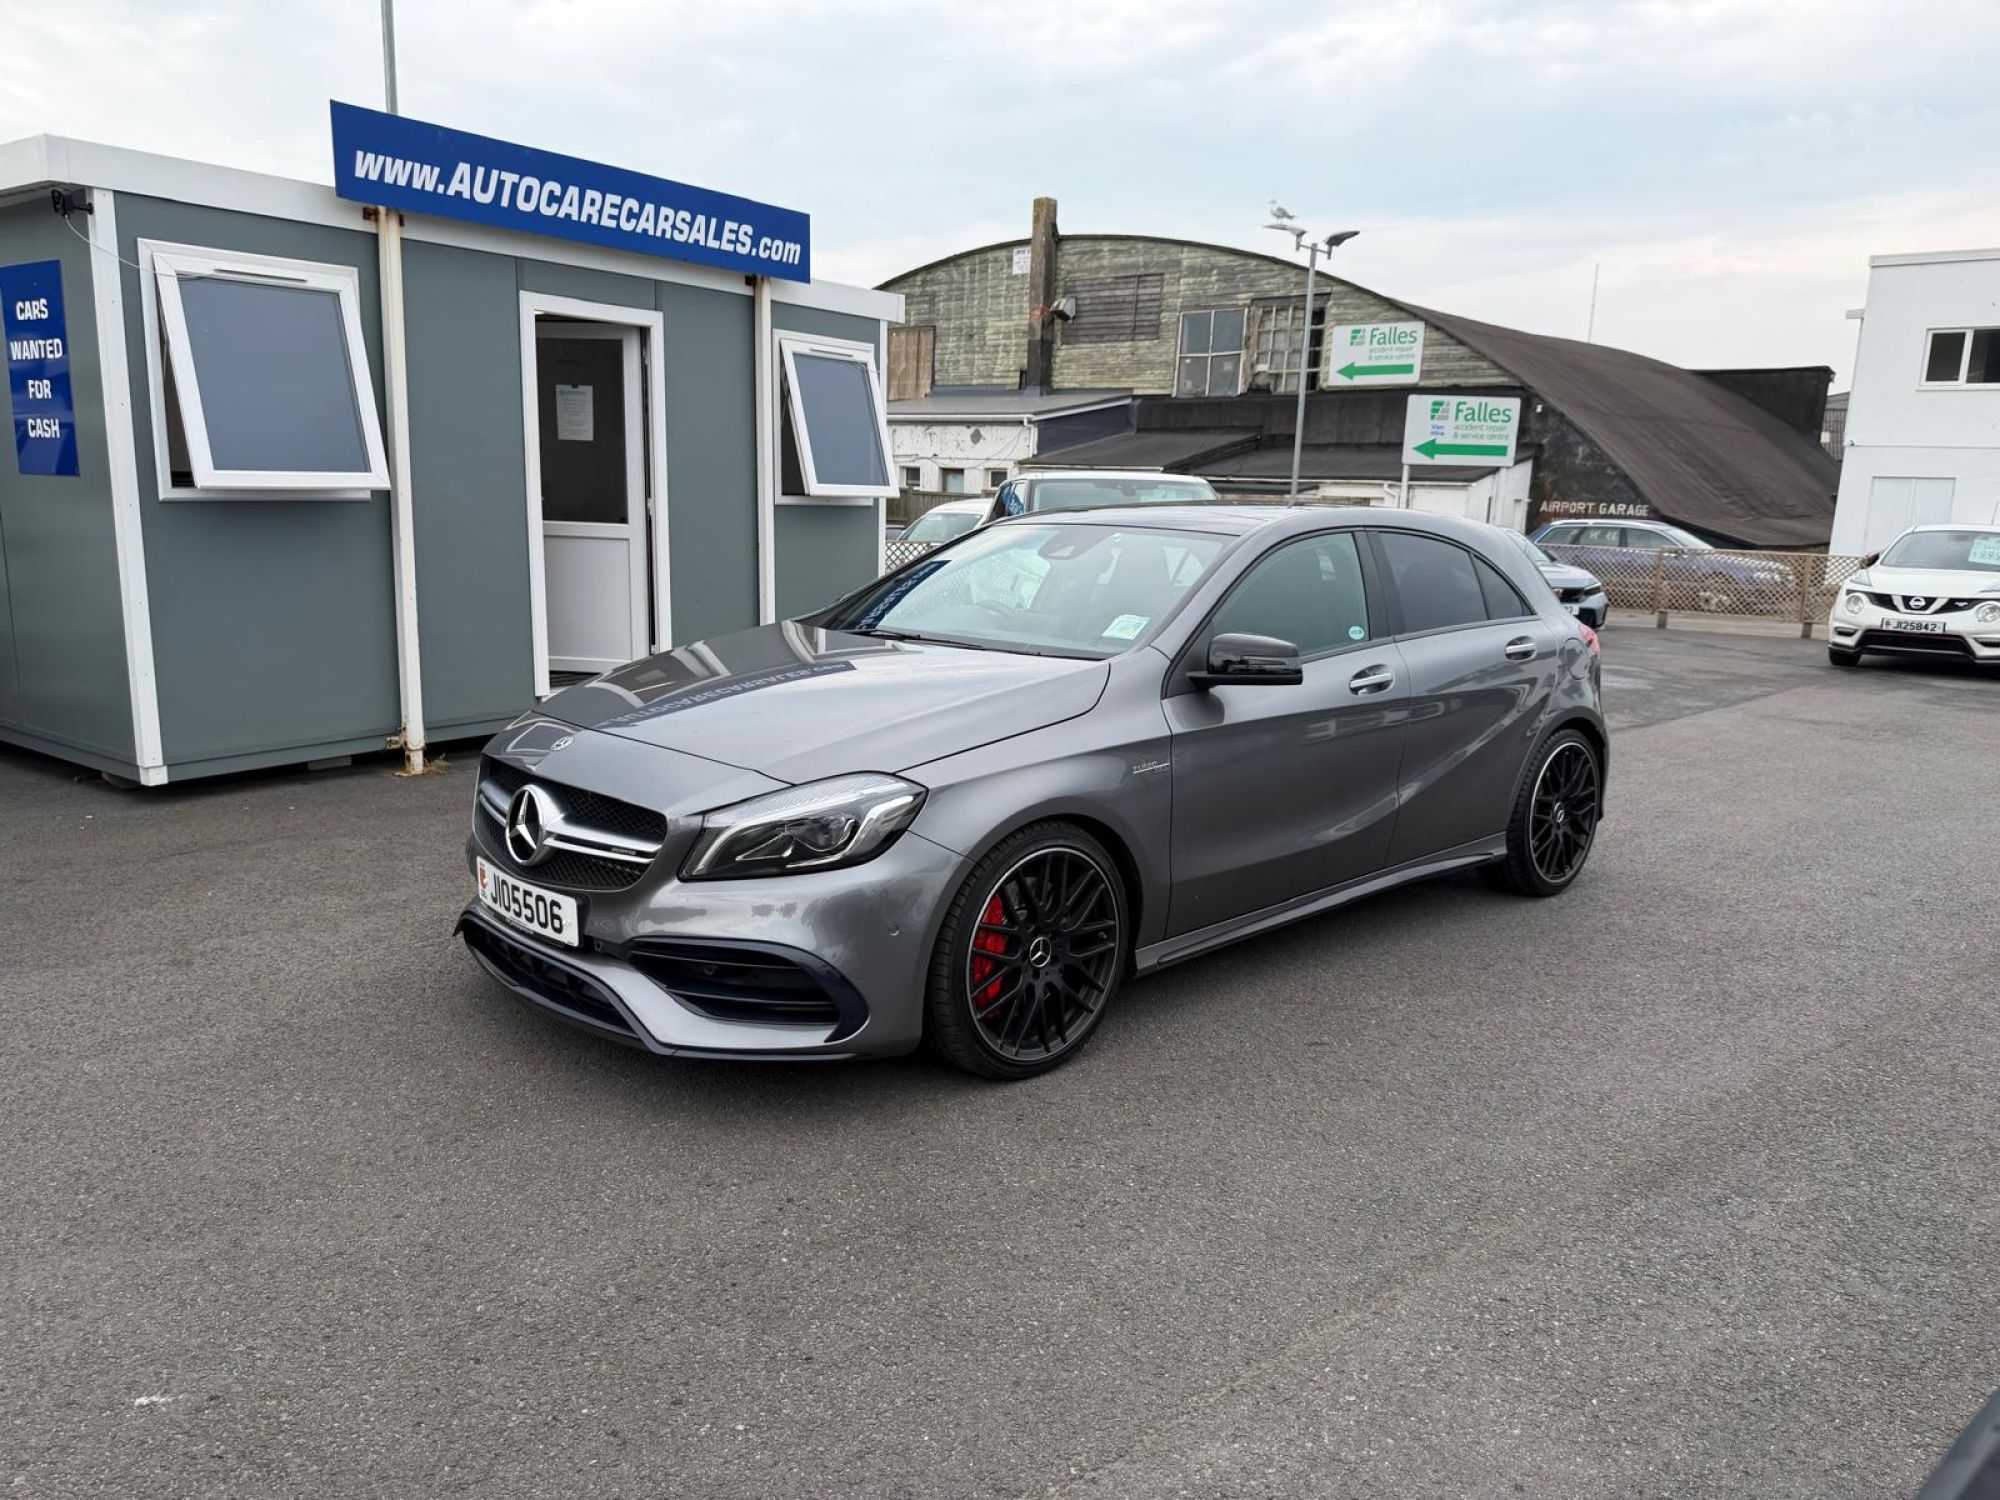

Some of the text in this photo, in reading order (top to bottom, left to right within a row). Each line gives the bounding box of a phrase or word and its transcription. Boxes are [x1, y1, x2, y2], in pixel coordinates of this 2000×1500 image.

[355, 150, 801, 265] www.AUTOCARECARSALES.com
[16, 298, 48, 320] CARS
[1369, 325, 1418, 346] Falles
[10, 338, 63, 360] WANTED
[28, 379, 51, 399] FOR
[1454, 401, 1512, 423] Falles
[28, 418, 60, 439] CASH
[1540, 500, 1650, 516] AIRPORT GARAGE
